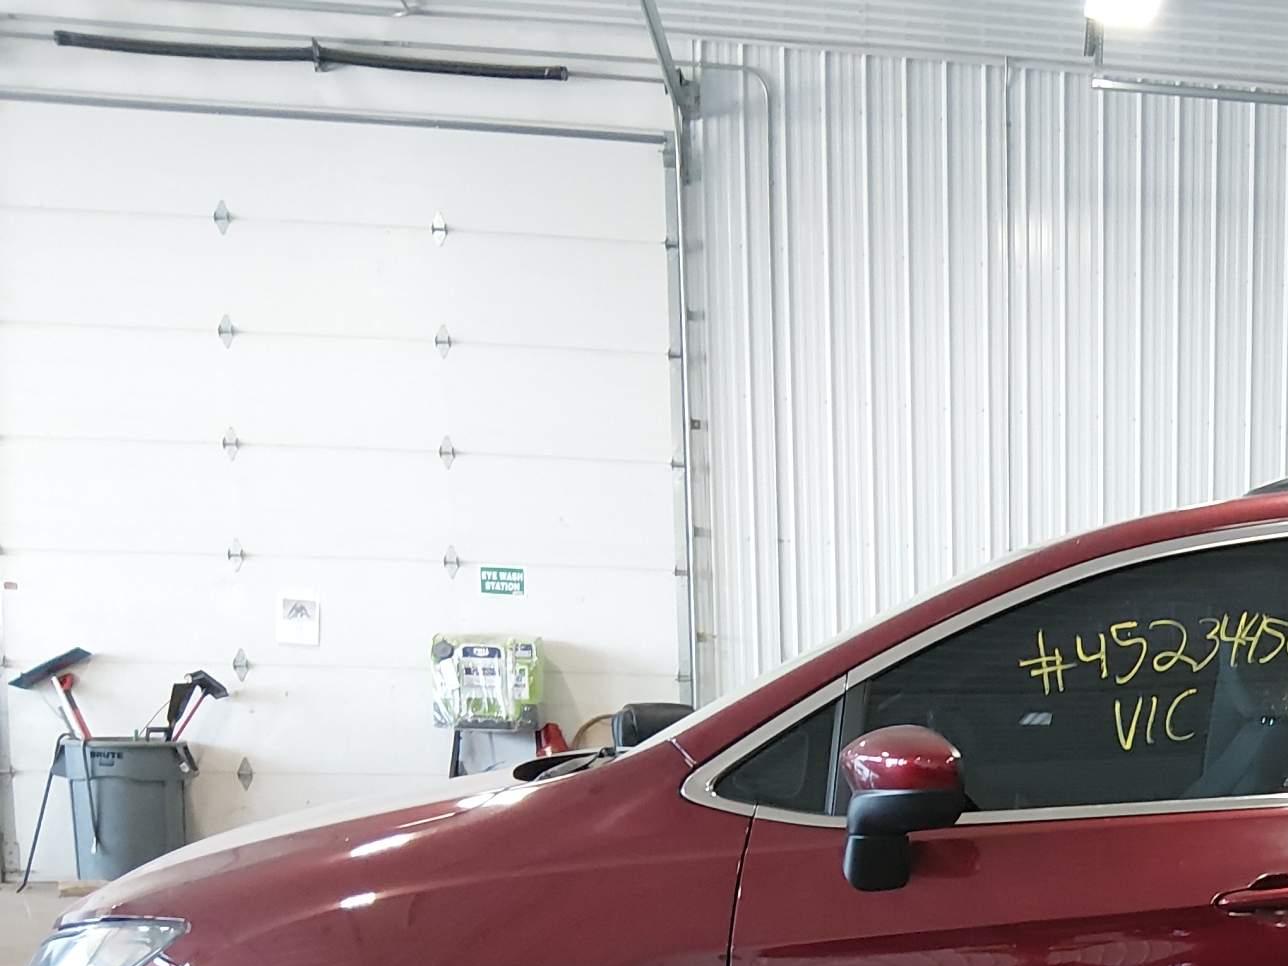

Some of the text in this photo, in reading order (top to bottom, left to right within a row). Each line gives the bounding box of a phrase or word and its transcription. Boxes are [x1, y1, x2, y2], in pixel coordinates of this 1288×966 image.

[481, 571, 524, 582] EYE WASH
[485, 581, 520, 592] STATION
[1113, 688, 1199, 752] VIC
